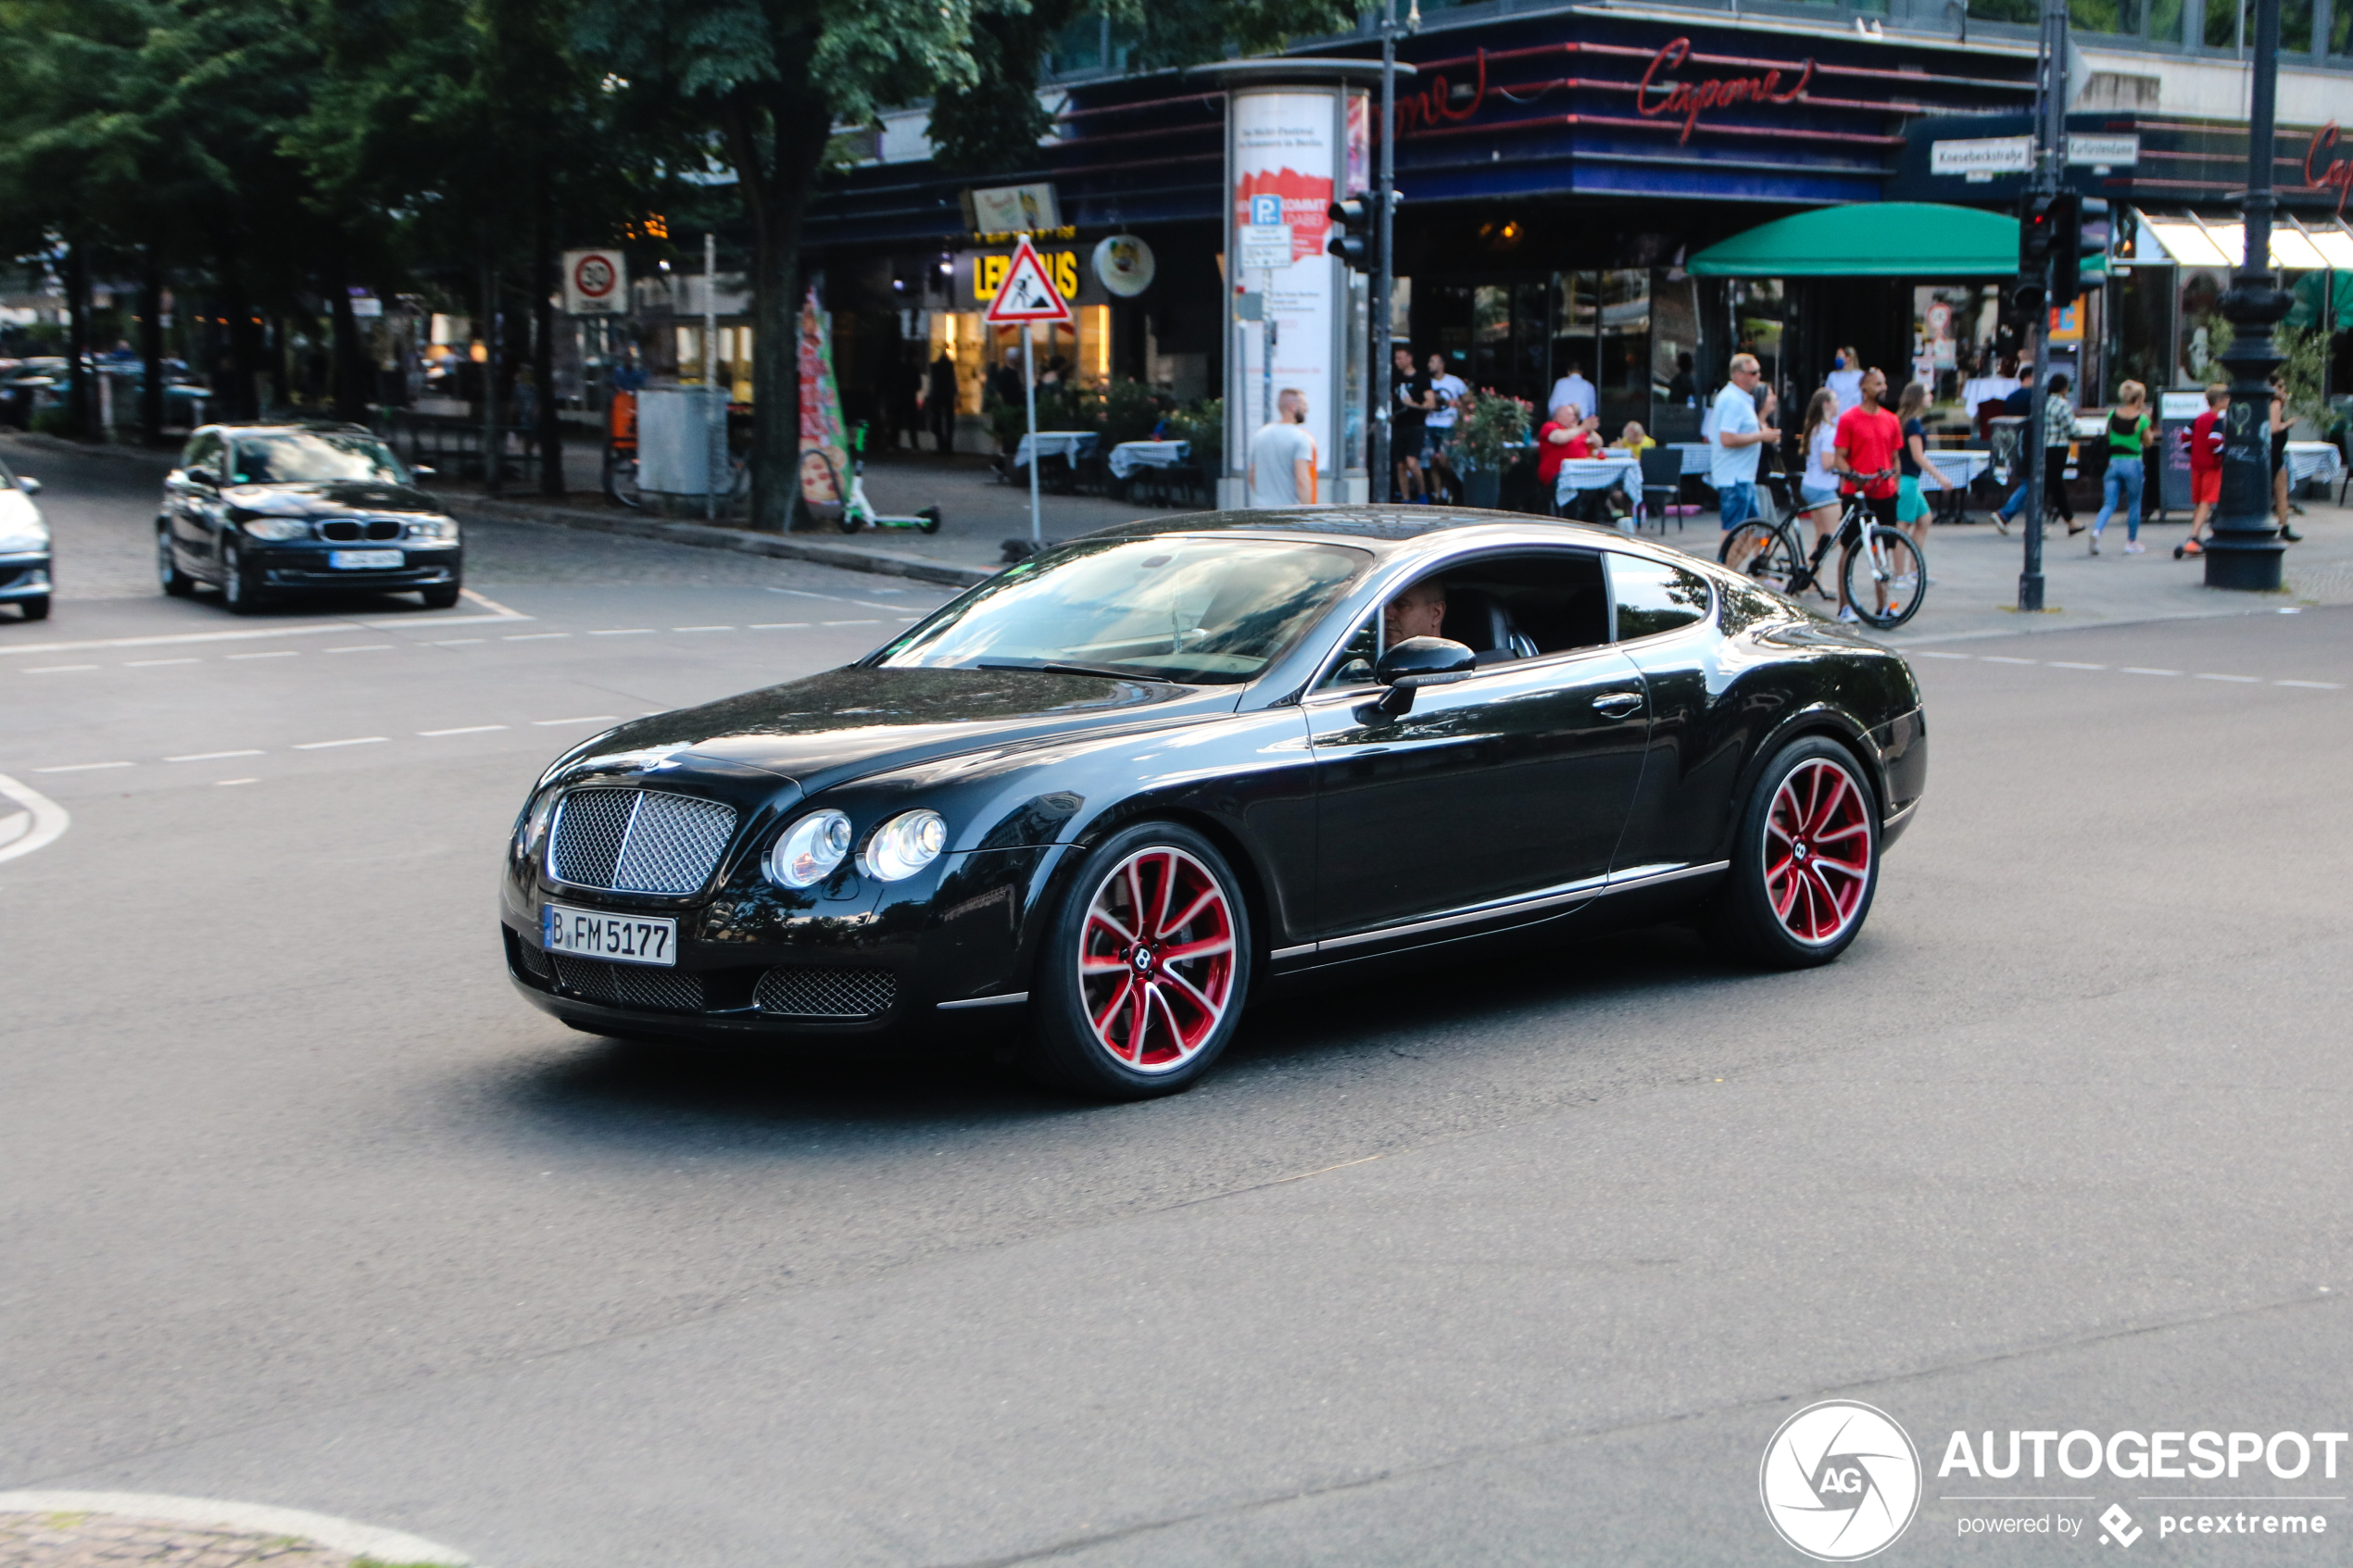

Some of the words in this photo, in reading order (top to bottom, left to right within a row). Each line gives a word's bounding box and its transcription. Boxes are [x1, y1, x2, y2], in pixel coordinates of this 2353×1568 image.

[1638, 36, 1814, 146] Capone
[1939, 148, 2023, 164] Knesebeckstraße
[583, 264, 610, 287] 30
[554, 911, 563, 944] B
[575, 916, 601, 951] FM
[607, 920, 669, 959] 5177
